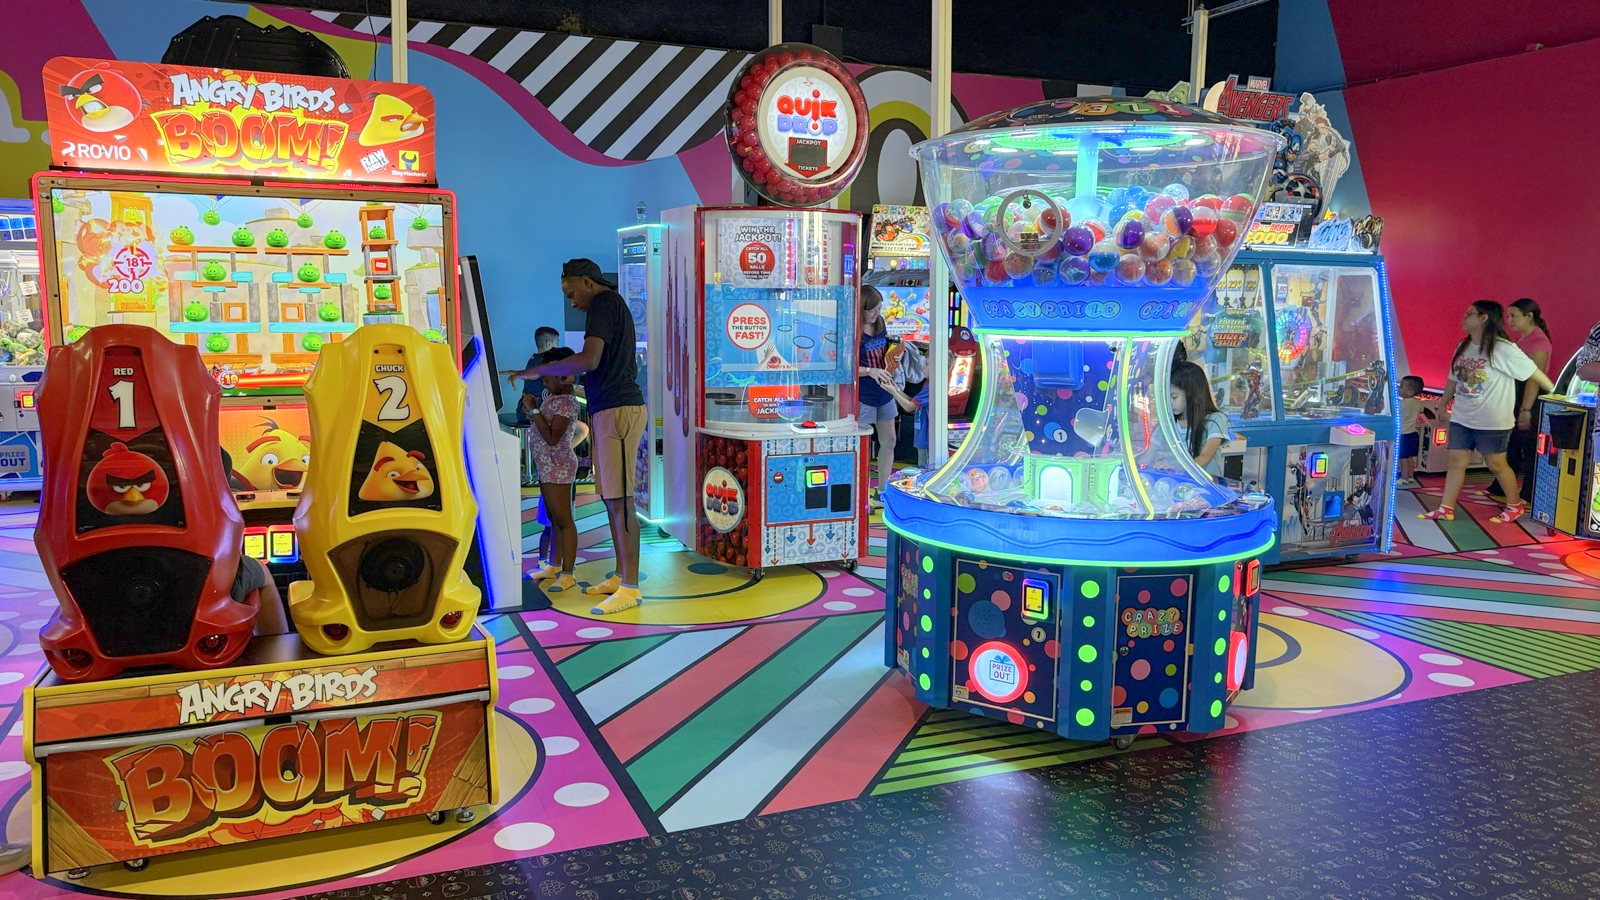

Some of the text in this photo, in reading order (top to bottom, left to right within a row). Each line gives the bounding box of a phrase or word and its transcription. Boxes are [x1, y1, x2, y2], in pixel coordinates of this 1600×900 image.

[1249, 78, 1268, 90] MARVEL
[170, 73, 335, 112] ANGRY BIRDS
[1217, 77, 1293, 121] AVENGERS
[777, 115, 838, 136] DROP
[152, 110, 349, 173] BOOM!
[78, 144, 131, 160] ROVIO
[361, 149, 387, 166] RAW
[740, 225, 758, 233] WIN
[734, 233, 782, 242] JACKPOT!
[747, 252, 767, 264] 50
[108, 277, 144, 294] 200
[983, 301, 1119, 318] CRAZY PRIZE
[733, 316, 767, 325] PRESS
[735, 332, 764, 340] FAST!
[113, 367, 134, 376] RED
[375, 364, 404, 372] CHUCK
[107, 379, 136, 428] 1
[372, 375, 410, 421] 2
[1058, 431, 1063, 441] 1
[0, 458, 26, 467] OUT
[1123, 609, 1177, 623] CRAZY
[1128, 622, 1182, 636] PRIZE
[992, 663, 1012, 673] PRIZE
[993, 671, 1010, 681] OUT
[177, 680, 282, 725] ANGRY
[282, 666, 378, 711] BIRDS
[107, 711, 442, 845] BOOM!
